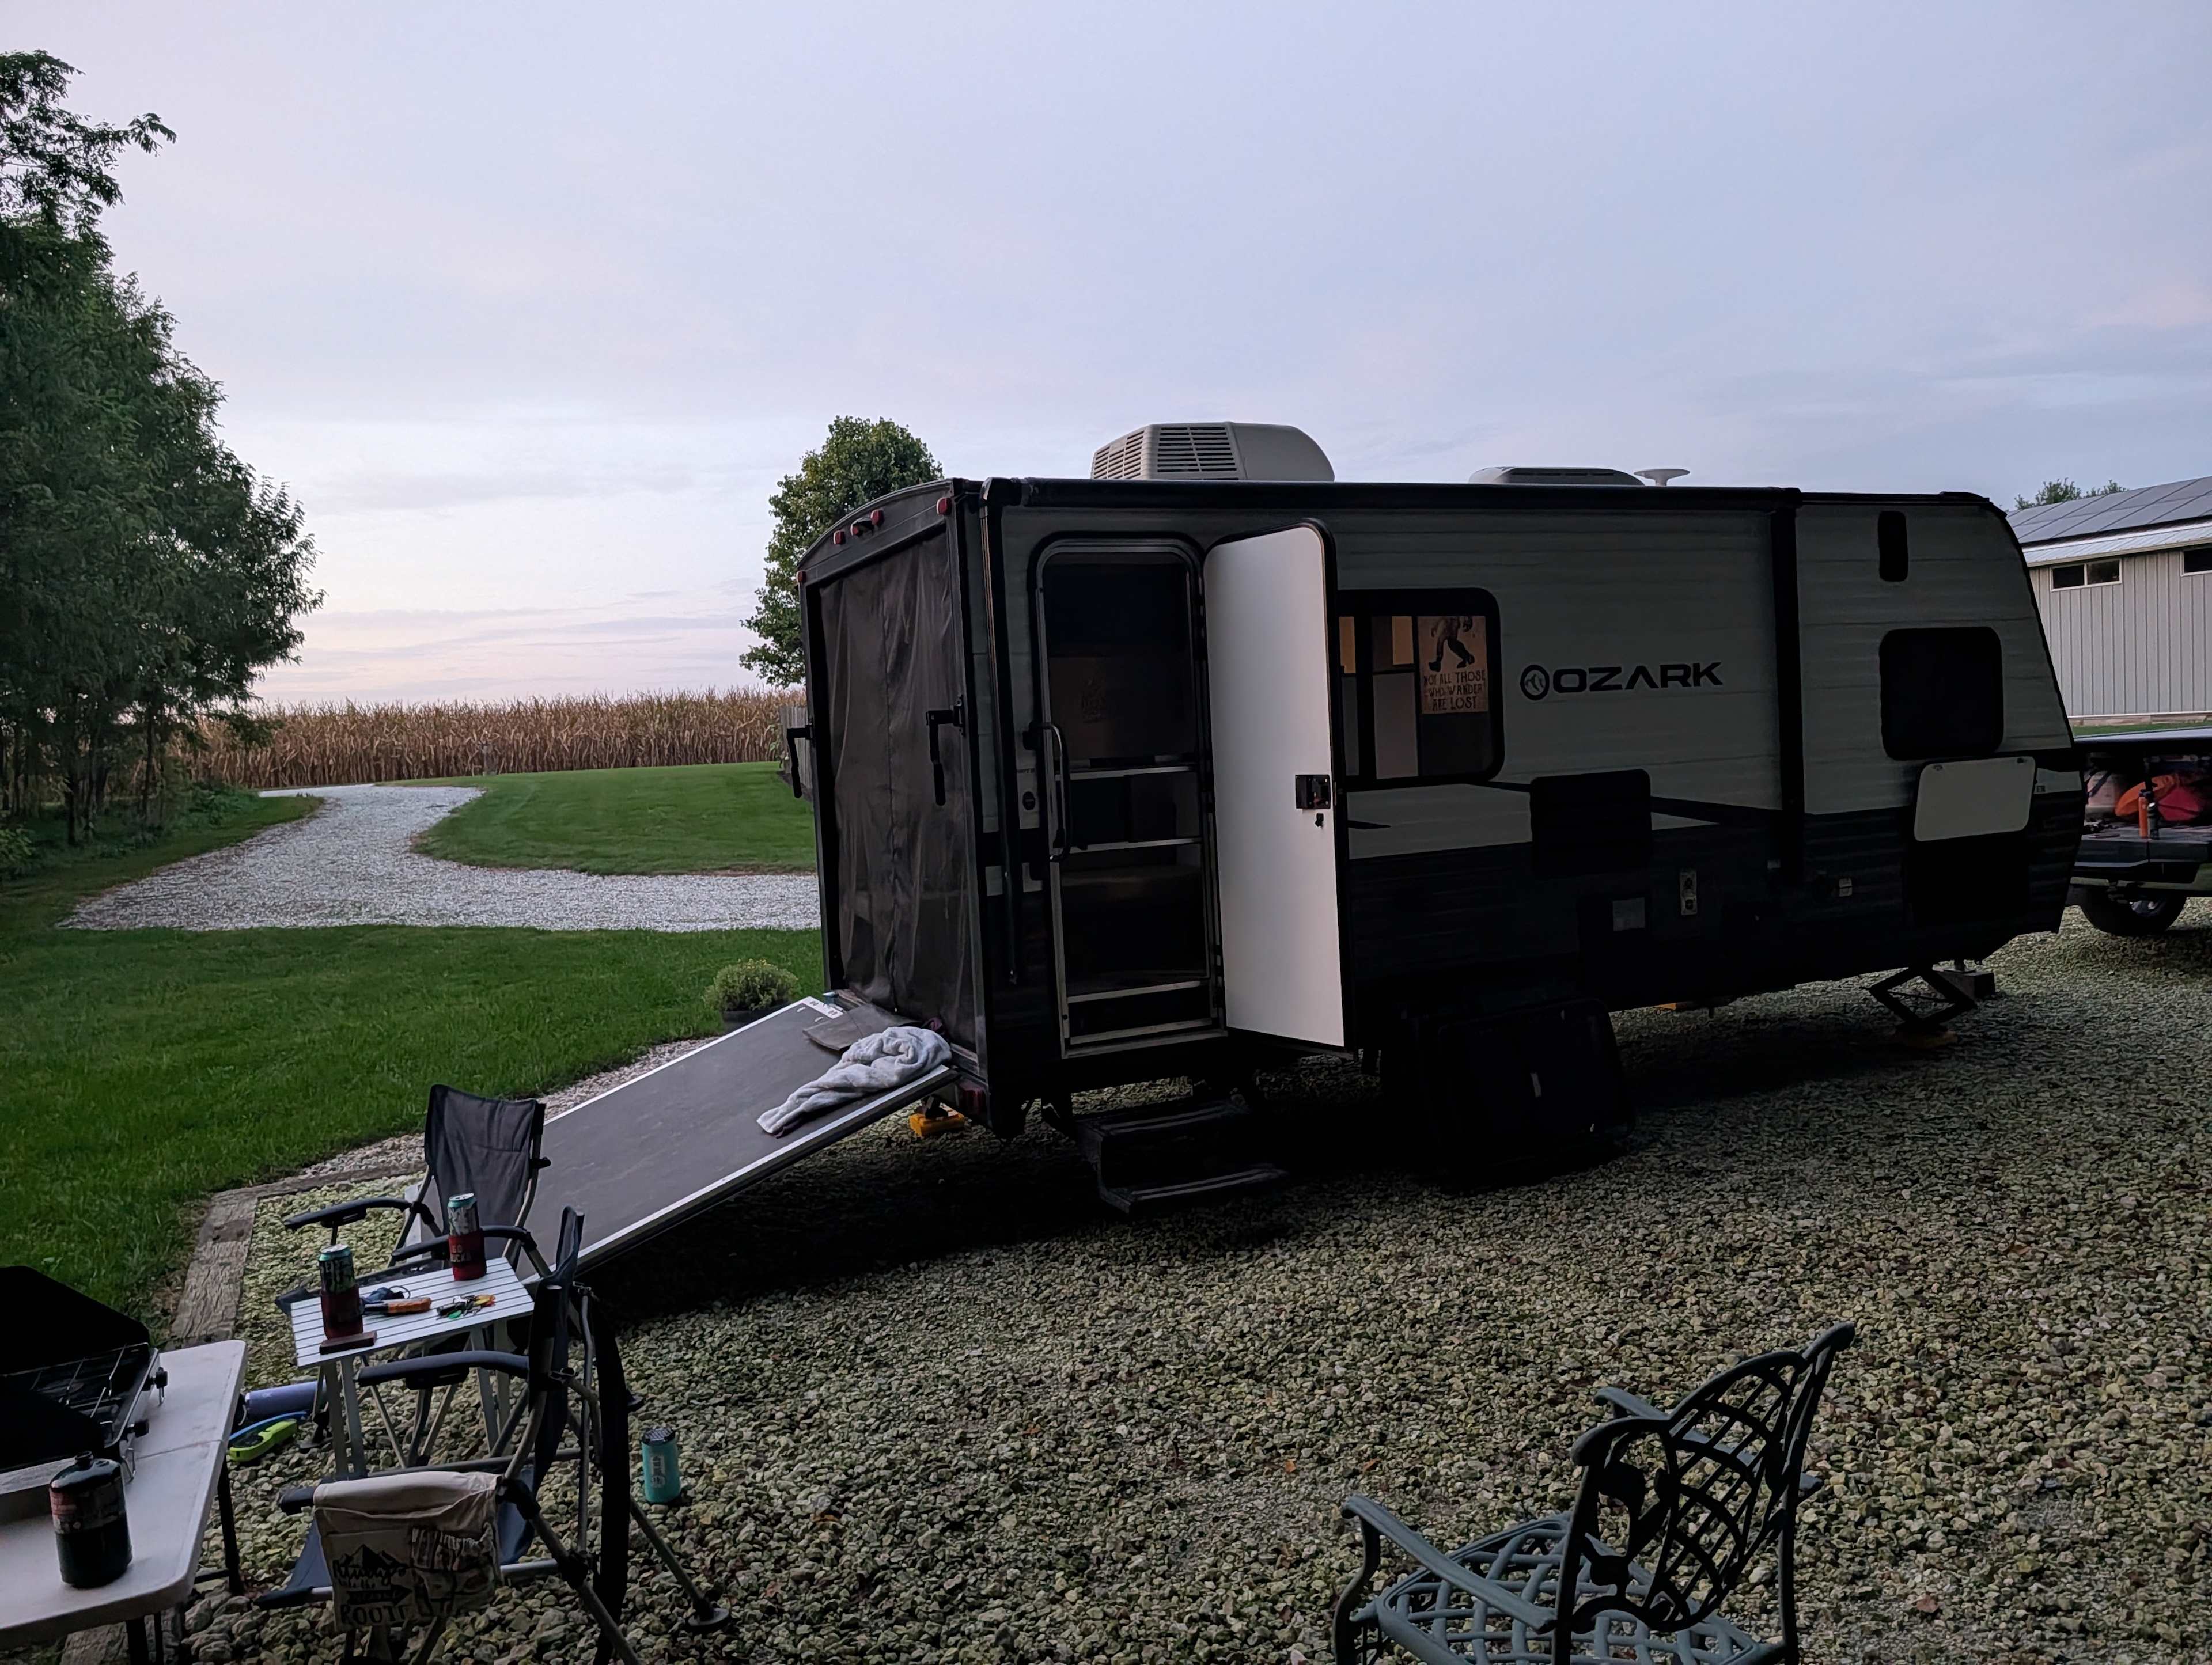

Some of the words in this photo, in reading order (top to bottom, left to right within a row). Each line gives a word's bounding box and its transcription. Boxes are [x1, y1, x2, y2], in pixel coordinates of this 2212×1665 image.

[1440, 673, 1452, 684] ALL
[1456, 669, 1486, 683] THOSE
[1554, 662, 1723, 693] OZARK
[1429, 685, 1445, 697] WHO
[1447, 684, 1482, 695] WANDER
[1433, 699, 1447, 711] ARE
[1451, 696, 1477, 710] LOST
